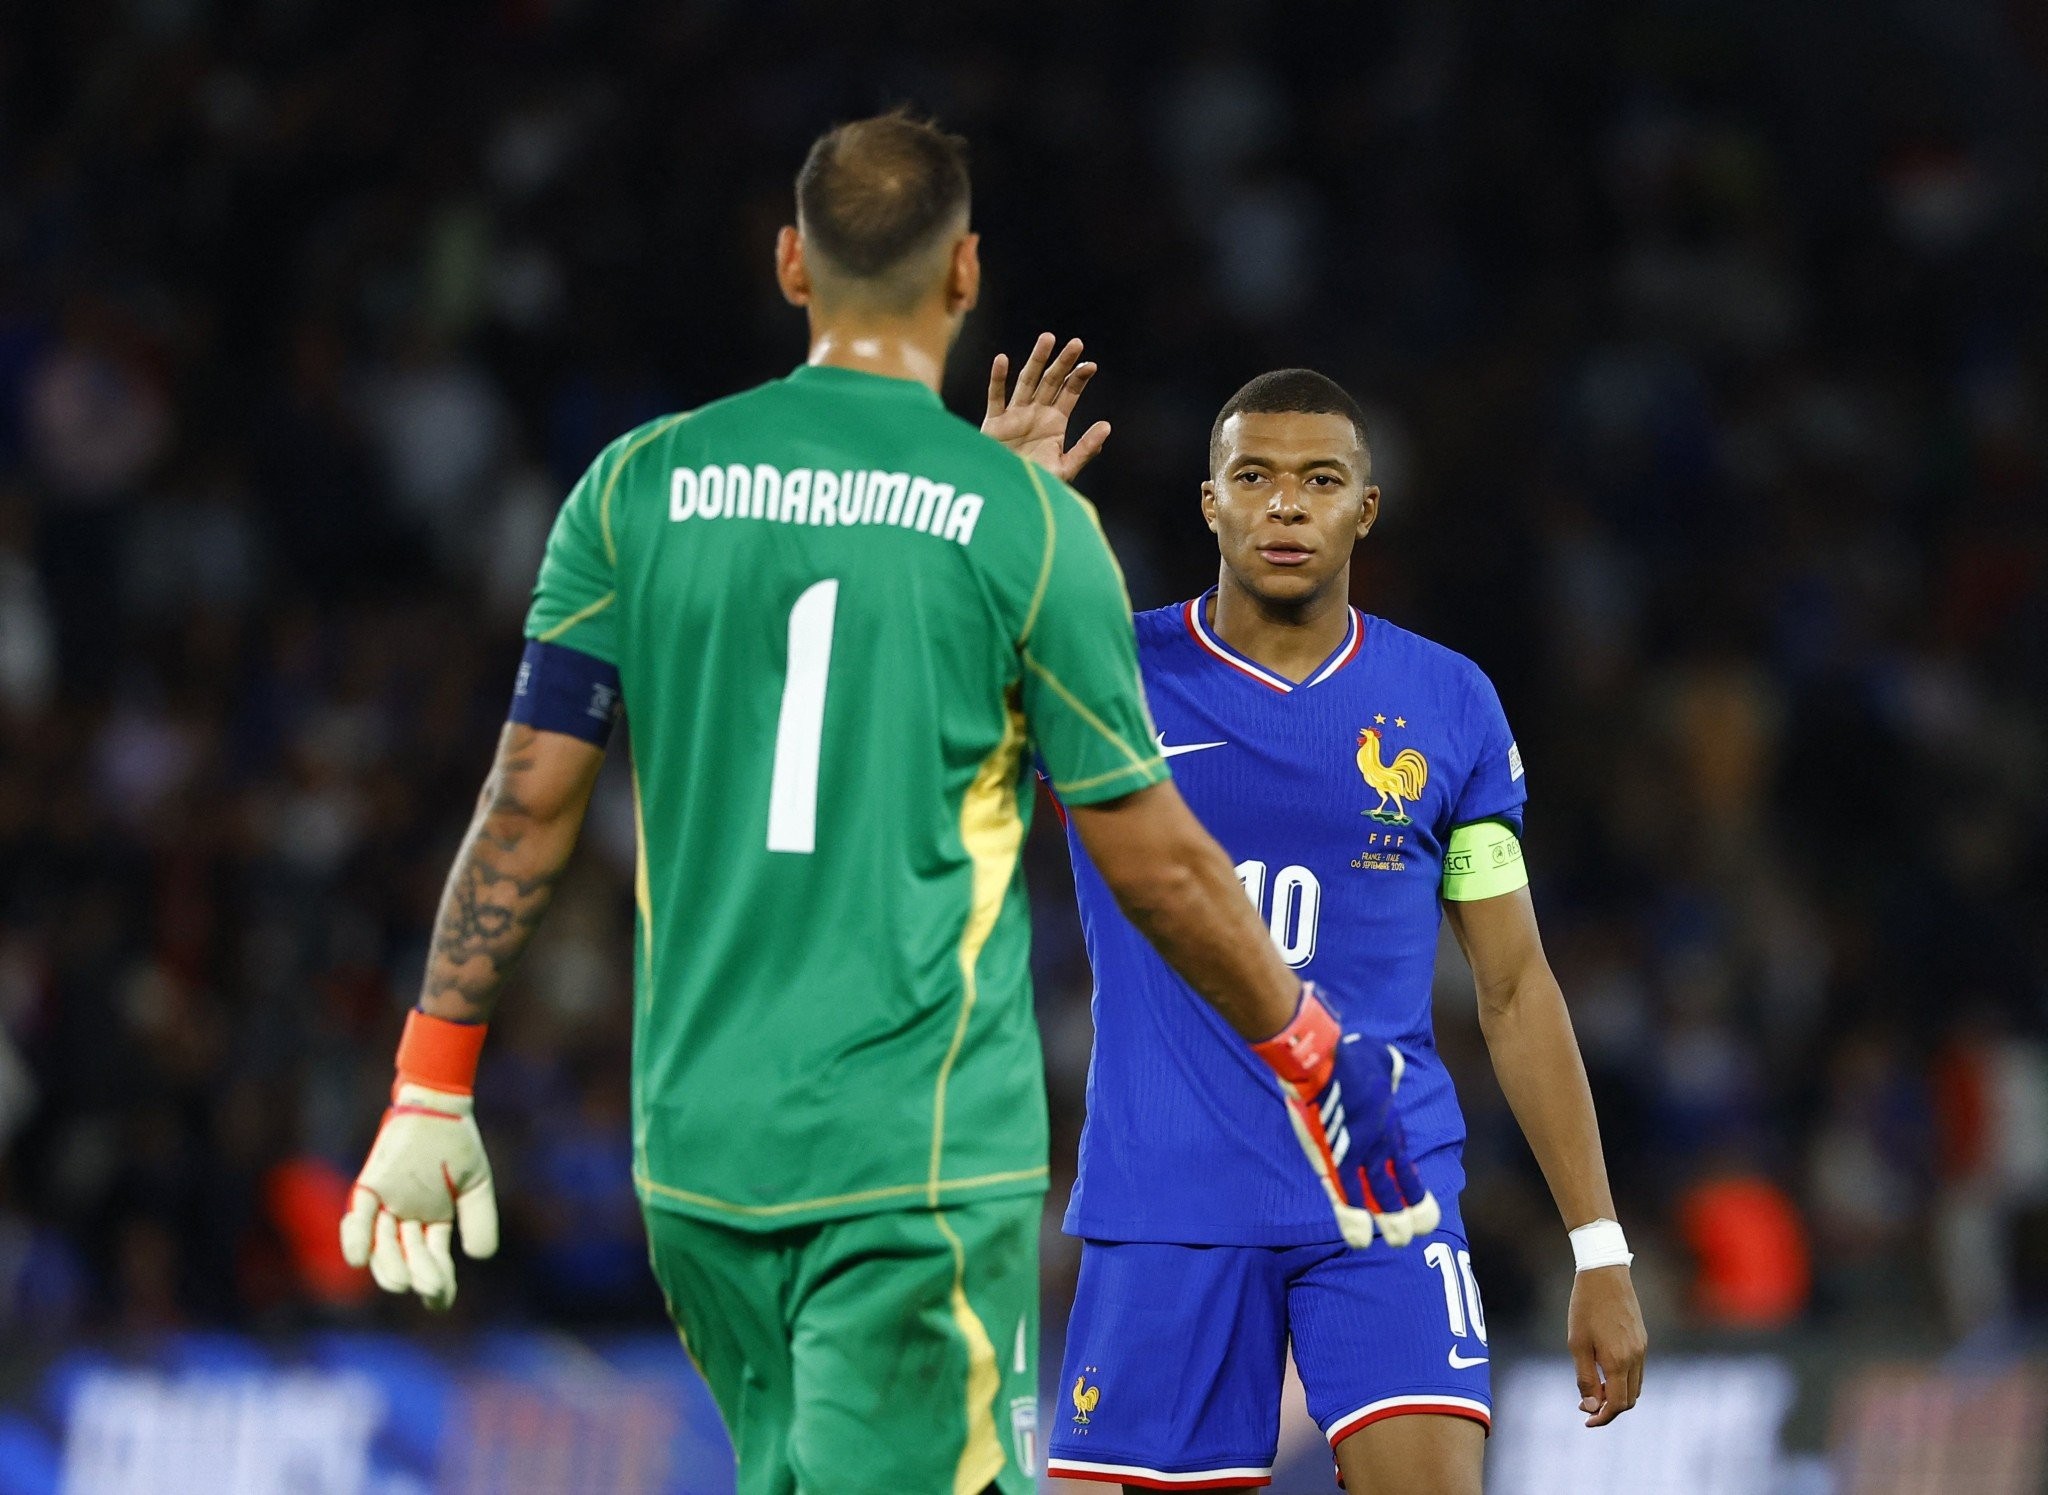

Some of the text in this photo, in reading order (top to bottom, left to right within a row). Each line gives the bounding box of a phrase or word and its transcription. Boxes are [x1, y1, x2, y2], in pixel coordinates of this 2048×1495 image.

[669, 463, 985, 546] DONNARUMMA
[766, 577, 840, 855] 1
[1351, 859, 1361, 868] 06
[1391, 862, 1405, 871] 2024
[1362, 852, 1382, 861] FRANCE
